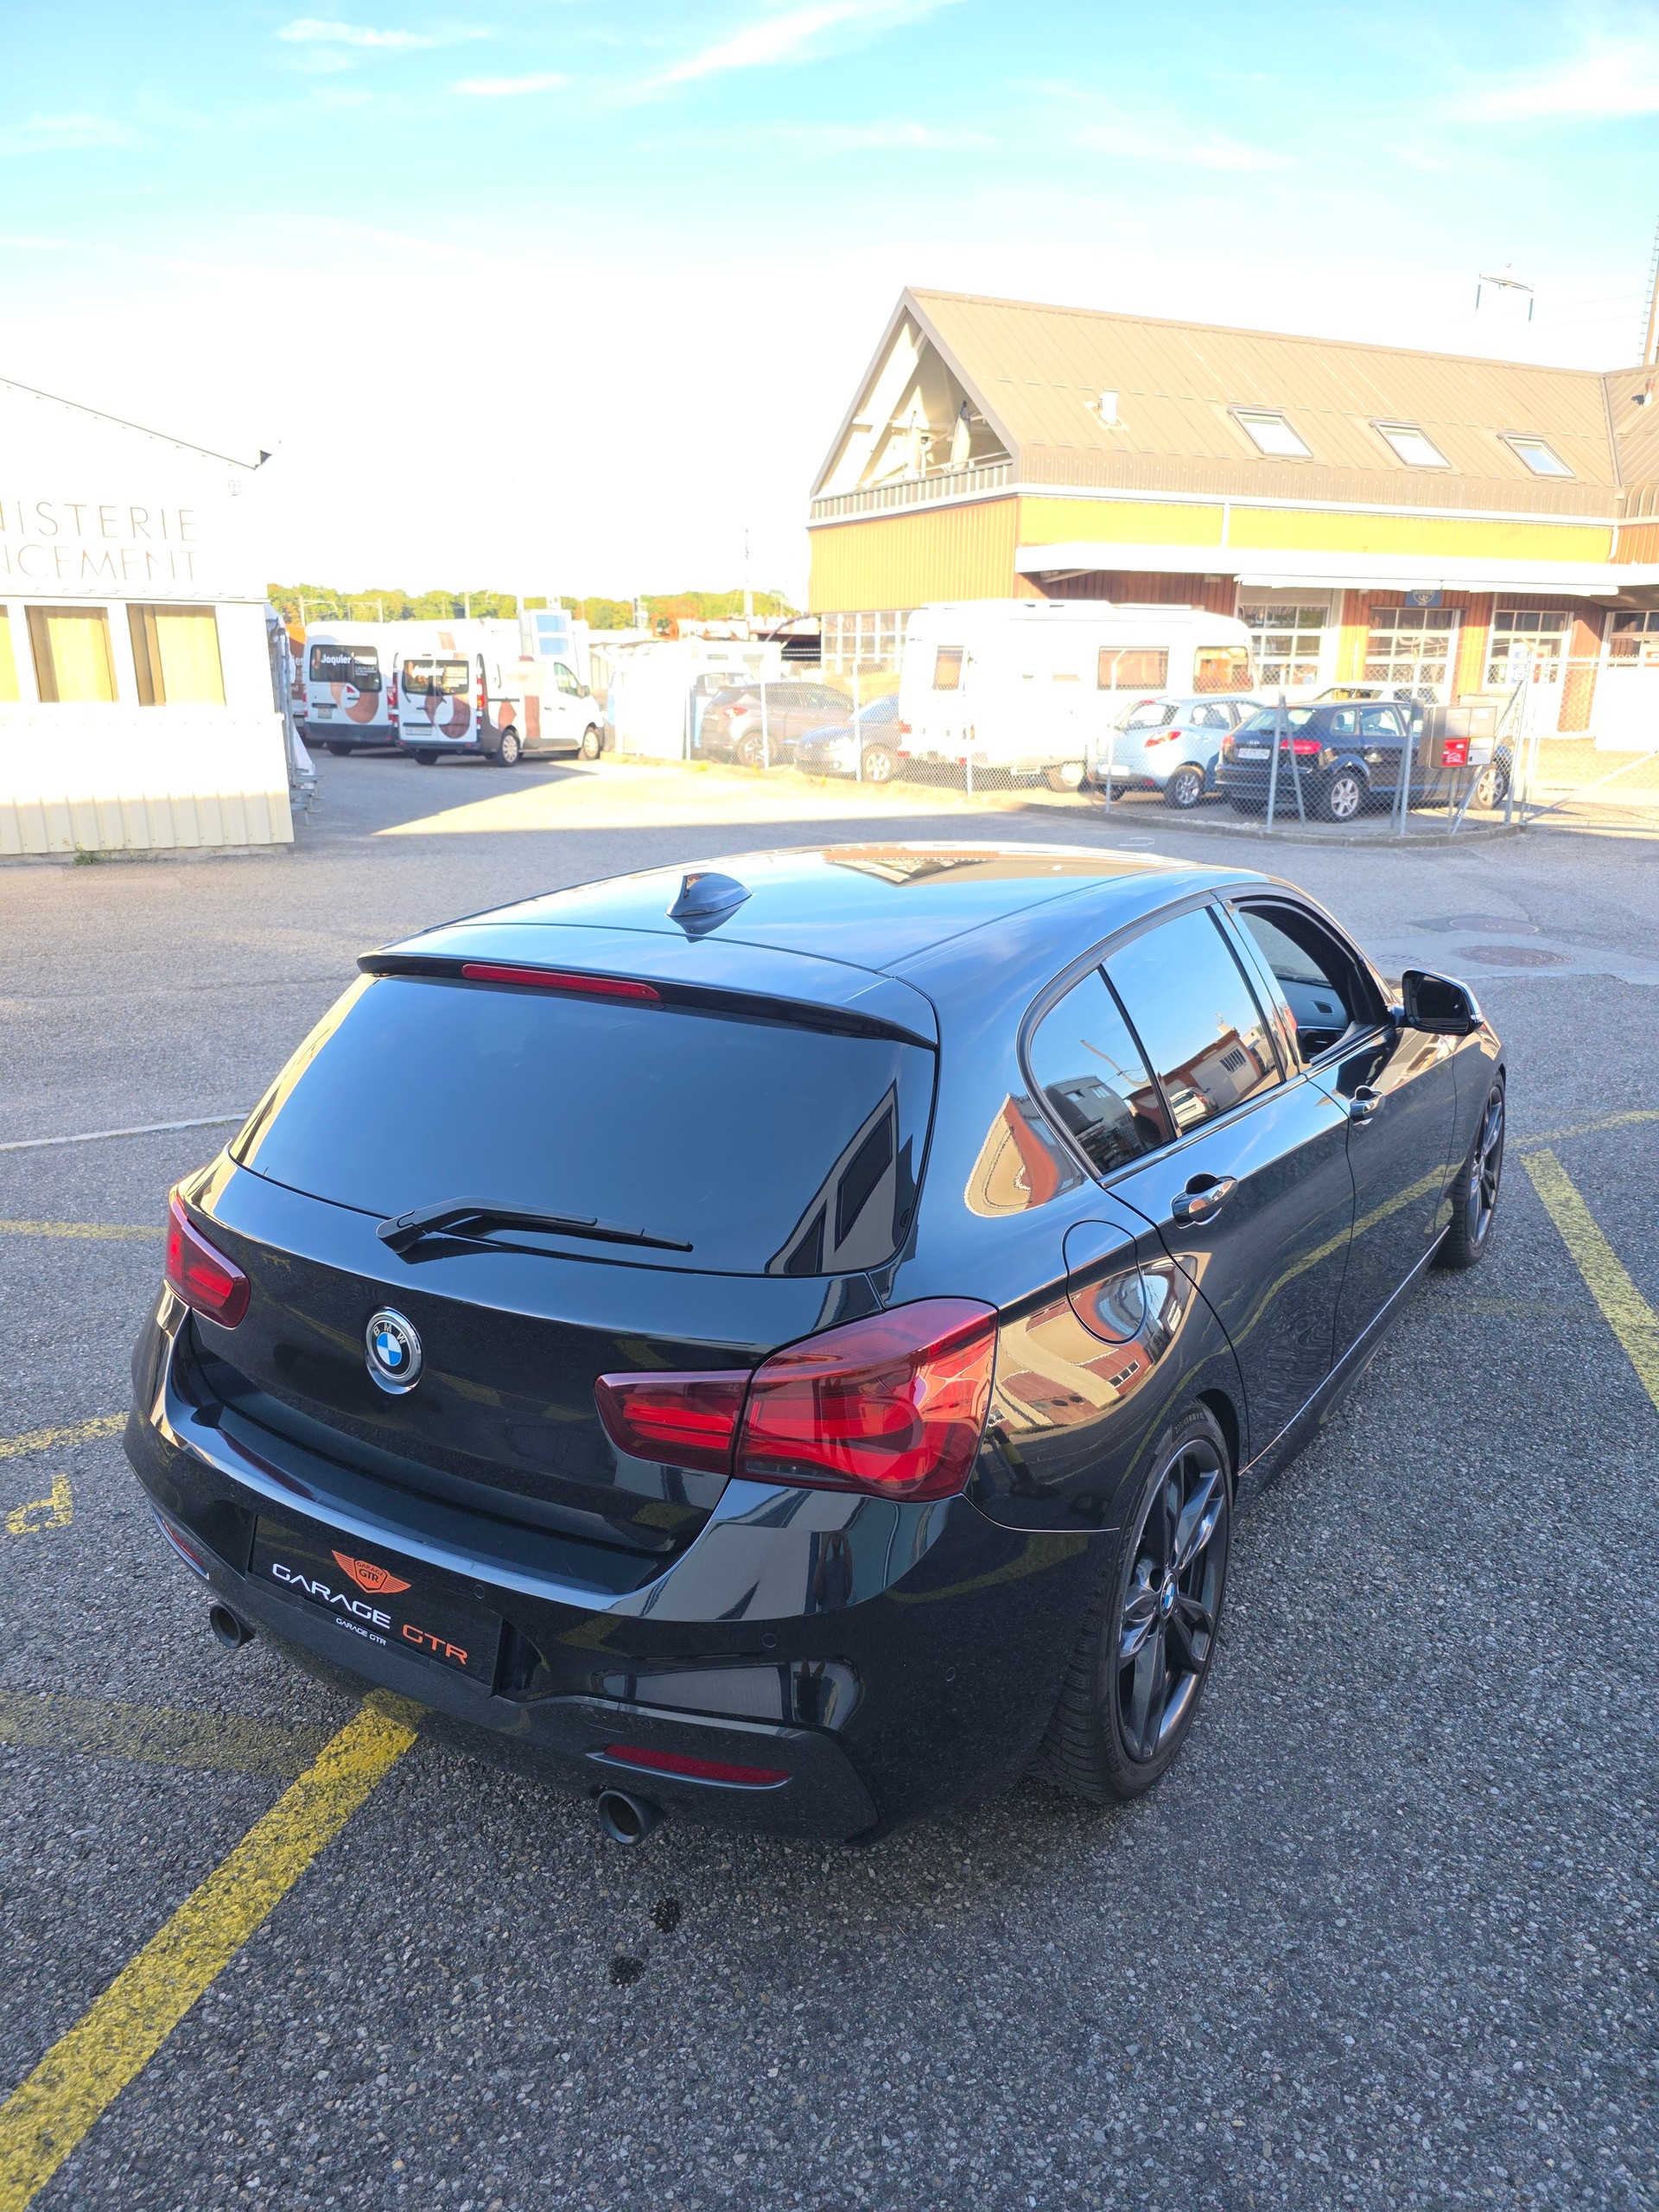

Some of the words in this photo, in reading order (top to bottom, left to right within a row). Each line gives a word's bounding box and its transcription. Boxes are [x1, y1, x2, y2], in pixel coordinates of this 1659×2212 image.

[372, 1322, 406, 1344] BMW
[356, 1561, 385, 1577] GARAGE
[359, 1568, 378, 1583] GTR
[272, 1563, 391, 1629] GARAGE
[403, 1624, 468, 1665] GTR
[336, 1618, 368, 1637] GARAGE
[369, 1633, 386, 1645] GTR
